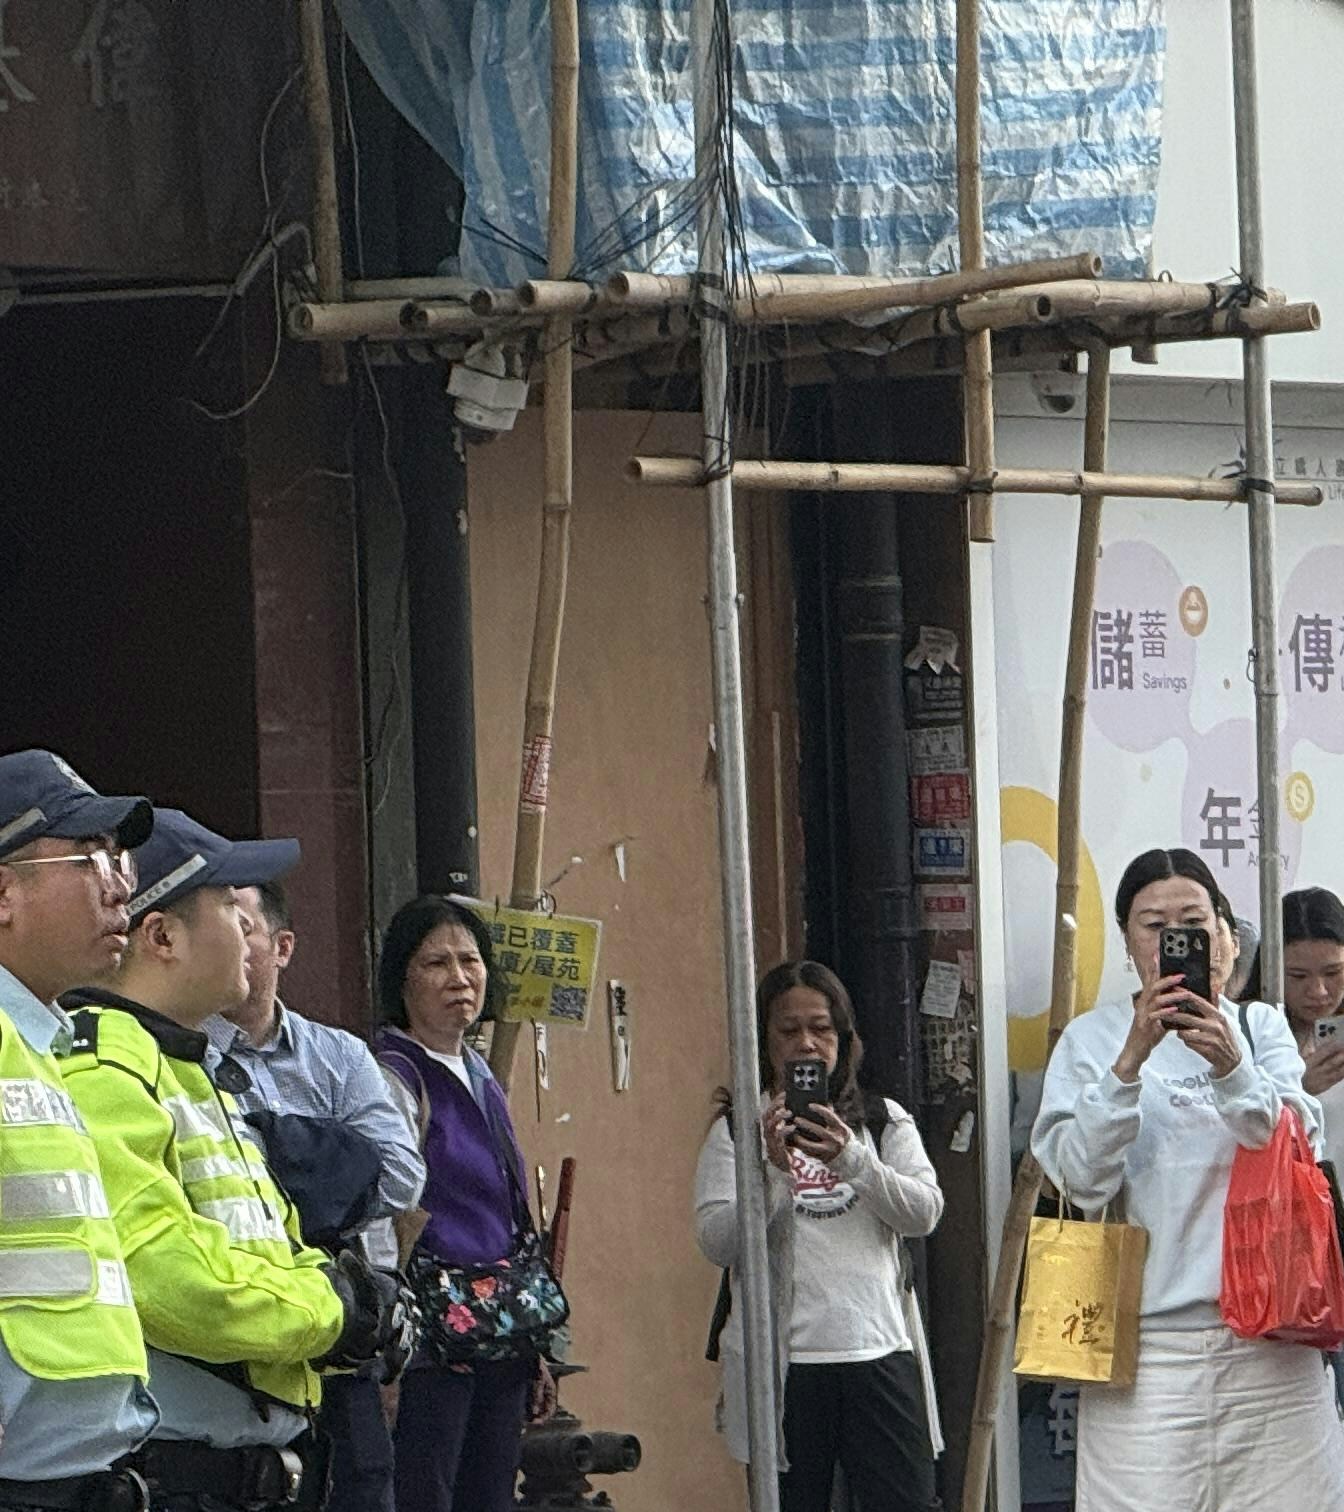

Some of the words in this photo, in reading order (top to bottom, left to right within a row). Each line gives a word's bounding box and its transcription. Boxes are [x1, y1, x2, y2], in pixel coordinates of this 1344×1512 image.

[1091, 608, 1168, 690] 儲蓄
[1142, 672, 1188, 691] Savings
[490, 950, 581, 981] 廈/屋苑
